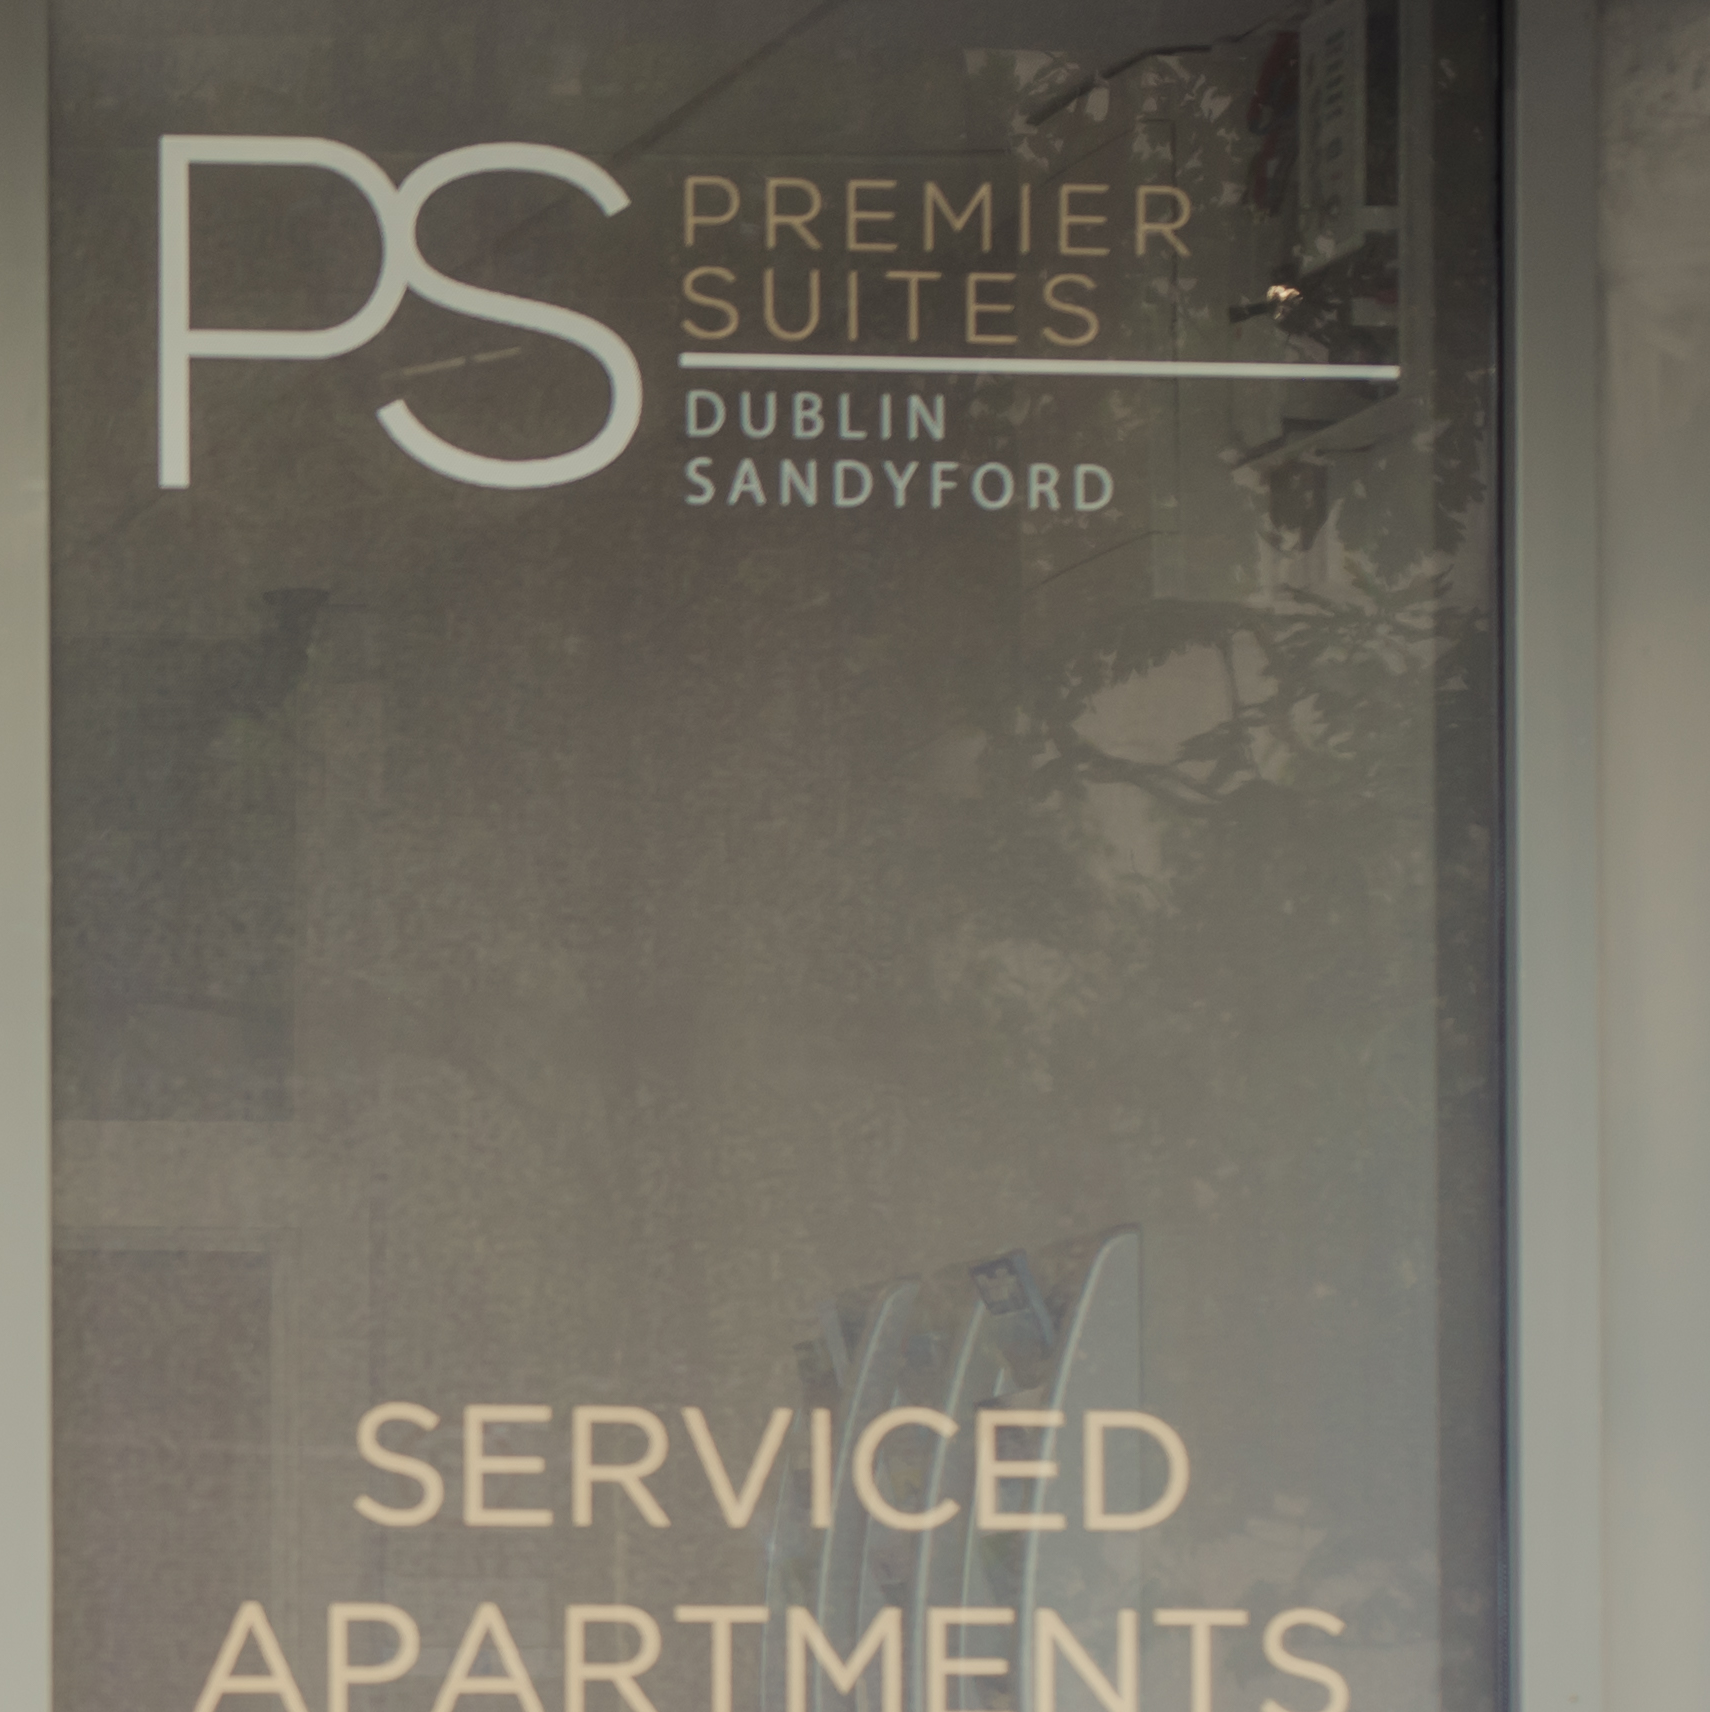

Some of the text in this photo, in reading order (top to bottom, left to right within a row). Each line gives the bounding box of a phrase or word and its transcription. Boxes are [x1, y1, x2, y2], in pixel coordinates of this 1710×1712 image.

[683, 174, 1194, 260] PREMIER
[157, 133, 644, 491] PS
[679, 266, 1103, 347] SUITES
[686, 389, 950, 442] DUBLIN
[684, 455, 1116, 513] SANDYFORD
[353, 1400, 1193, 1533] SERVICED
